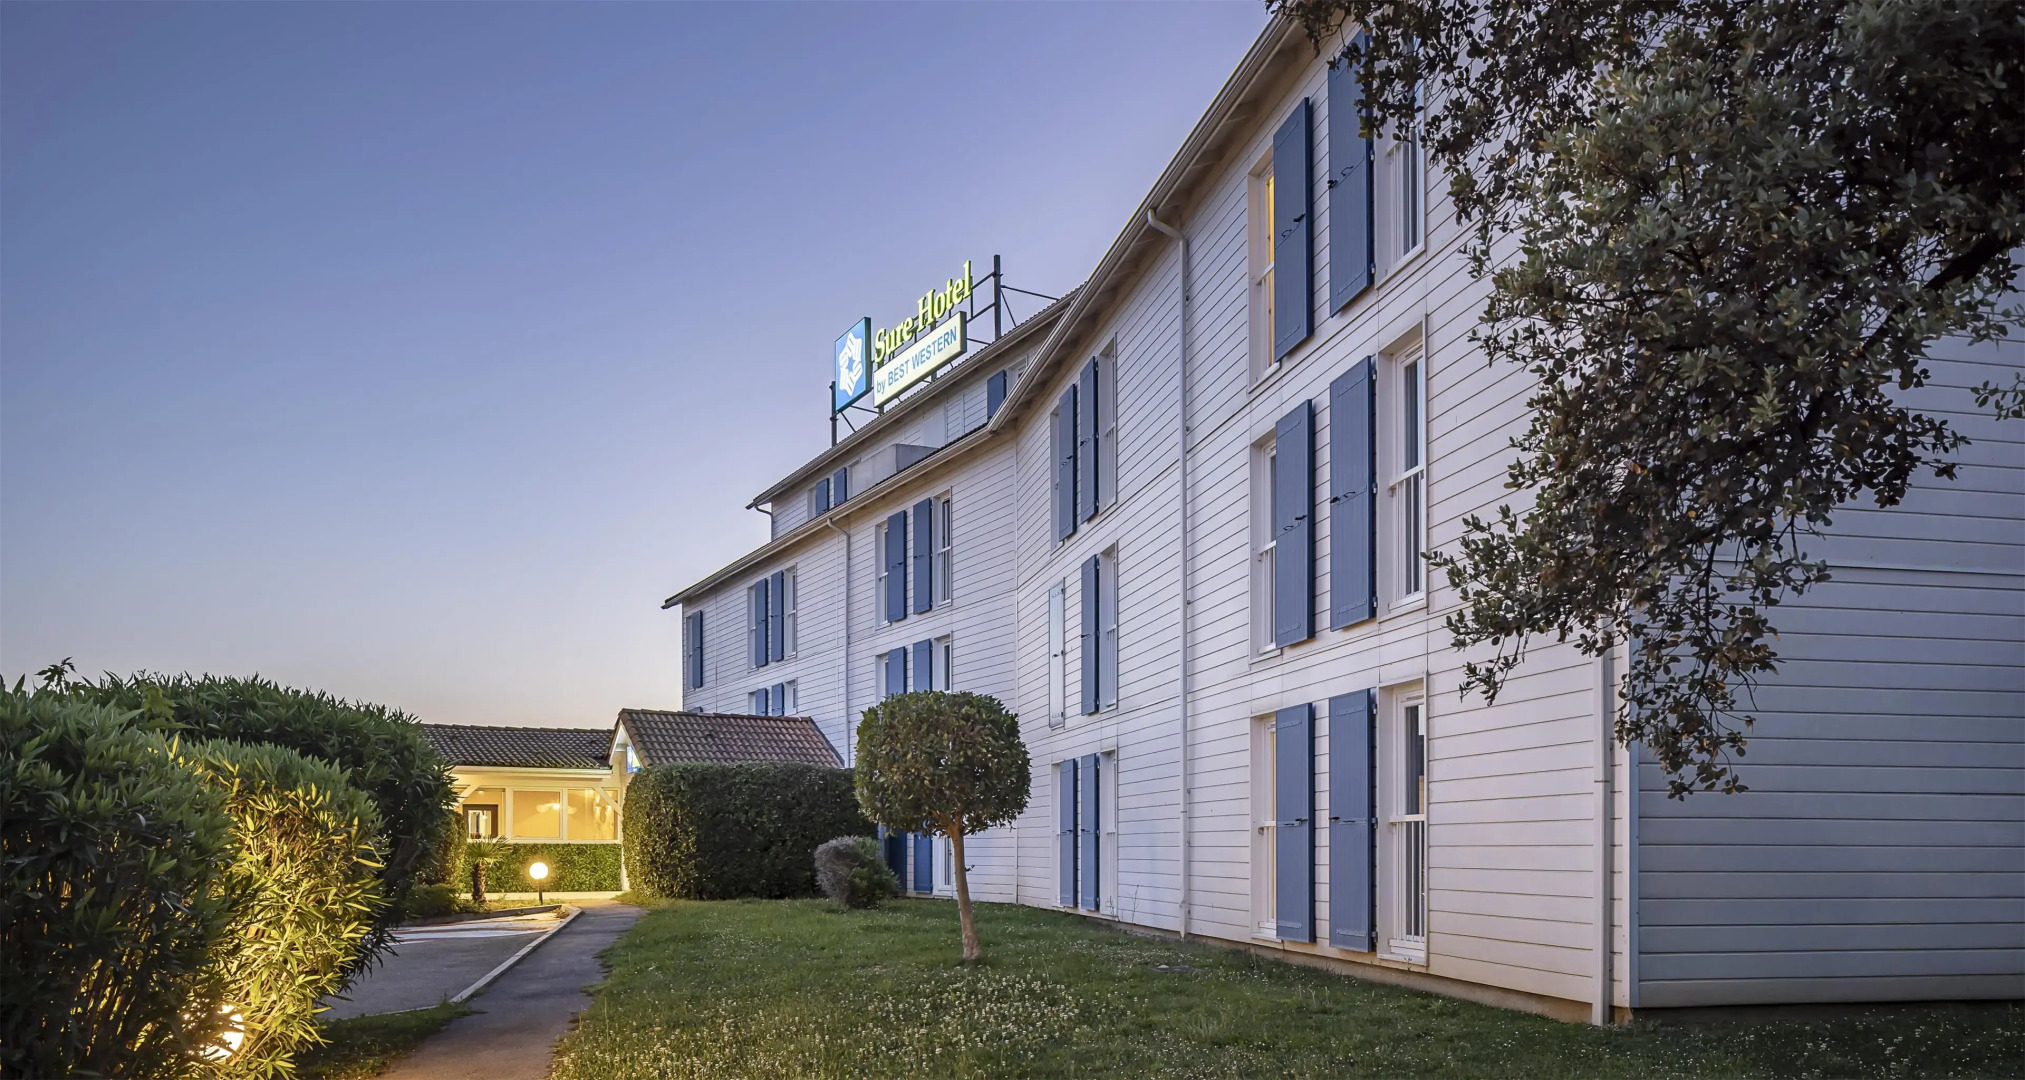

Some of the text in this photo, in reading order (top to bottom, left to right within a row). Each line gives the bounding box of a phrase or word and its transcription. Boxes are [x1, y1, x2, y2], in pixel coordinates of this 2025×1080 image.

[874, 259, 972, 364] Sure Hotel
[876, 325, 957, 395] by BEST WESTERN
